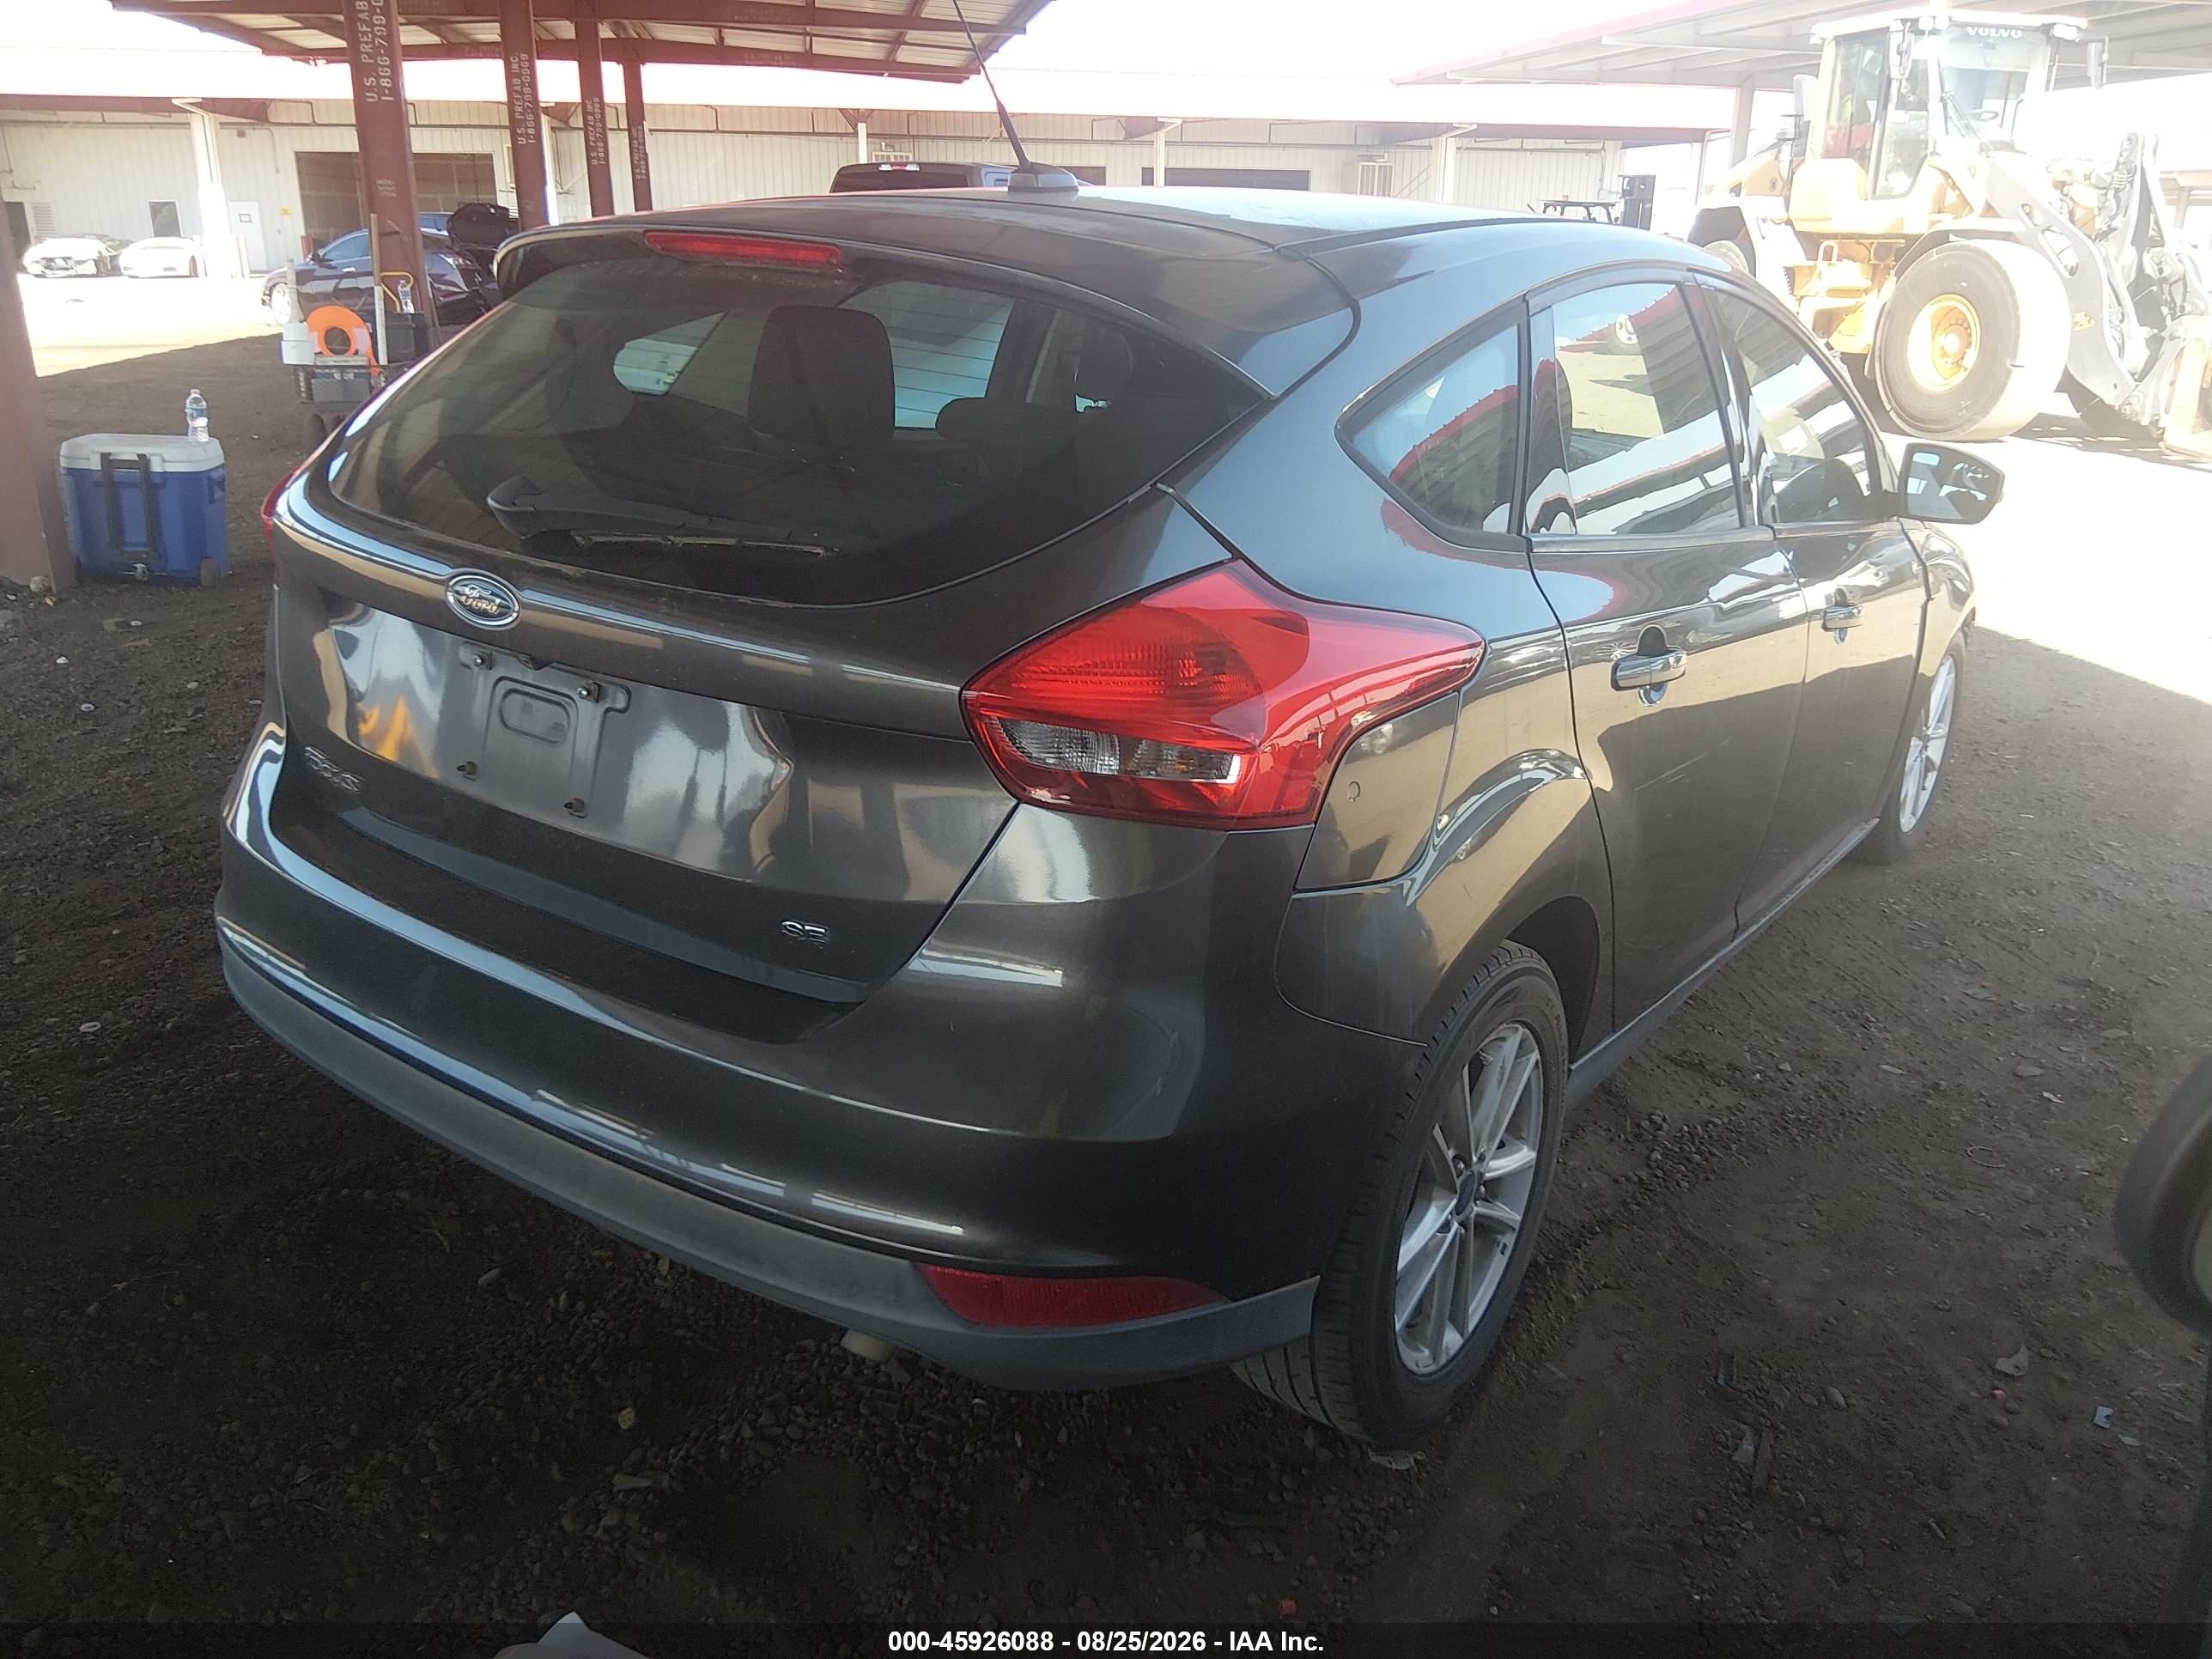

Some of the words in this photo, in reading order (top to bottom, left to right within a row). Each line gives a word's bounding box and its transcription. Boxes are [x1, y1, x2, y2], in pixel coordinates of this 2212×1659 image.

[356, 0, 374, 63] PREFAB
[1966, 27, 2022, 39] VOLVO
[363, 71, 378, 102] U.S.
[512, 78, 525, 119] PREFAB
[453, 583, 502, 616] Ford
[781, 921, 827, 946] SE
